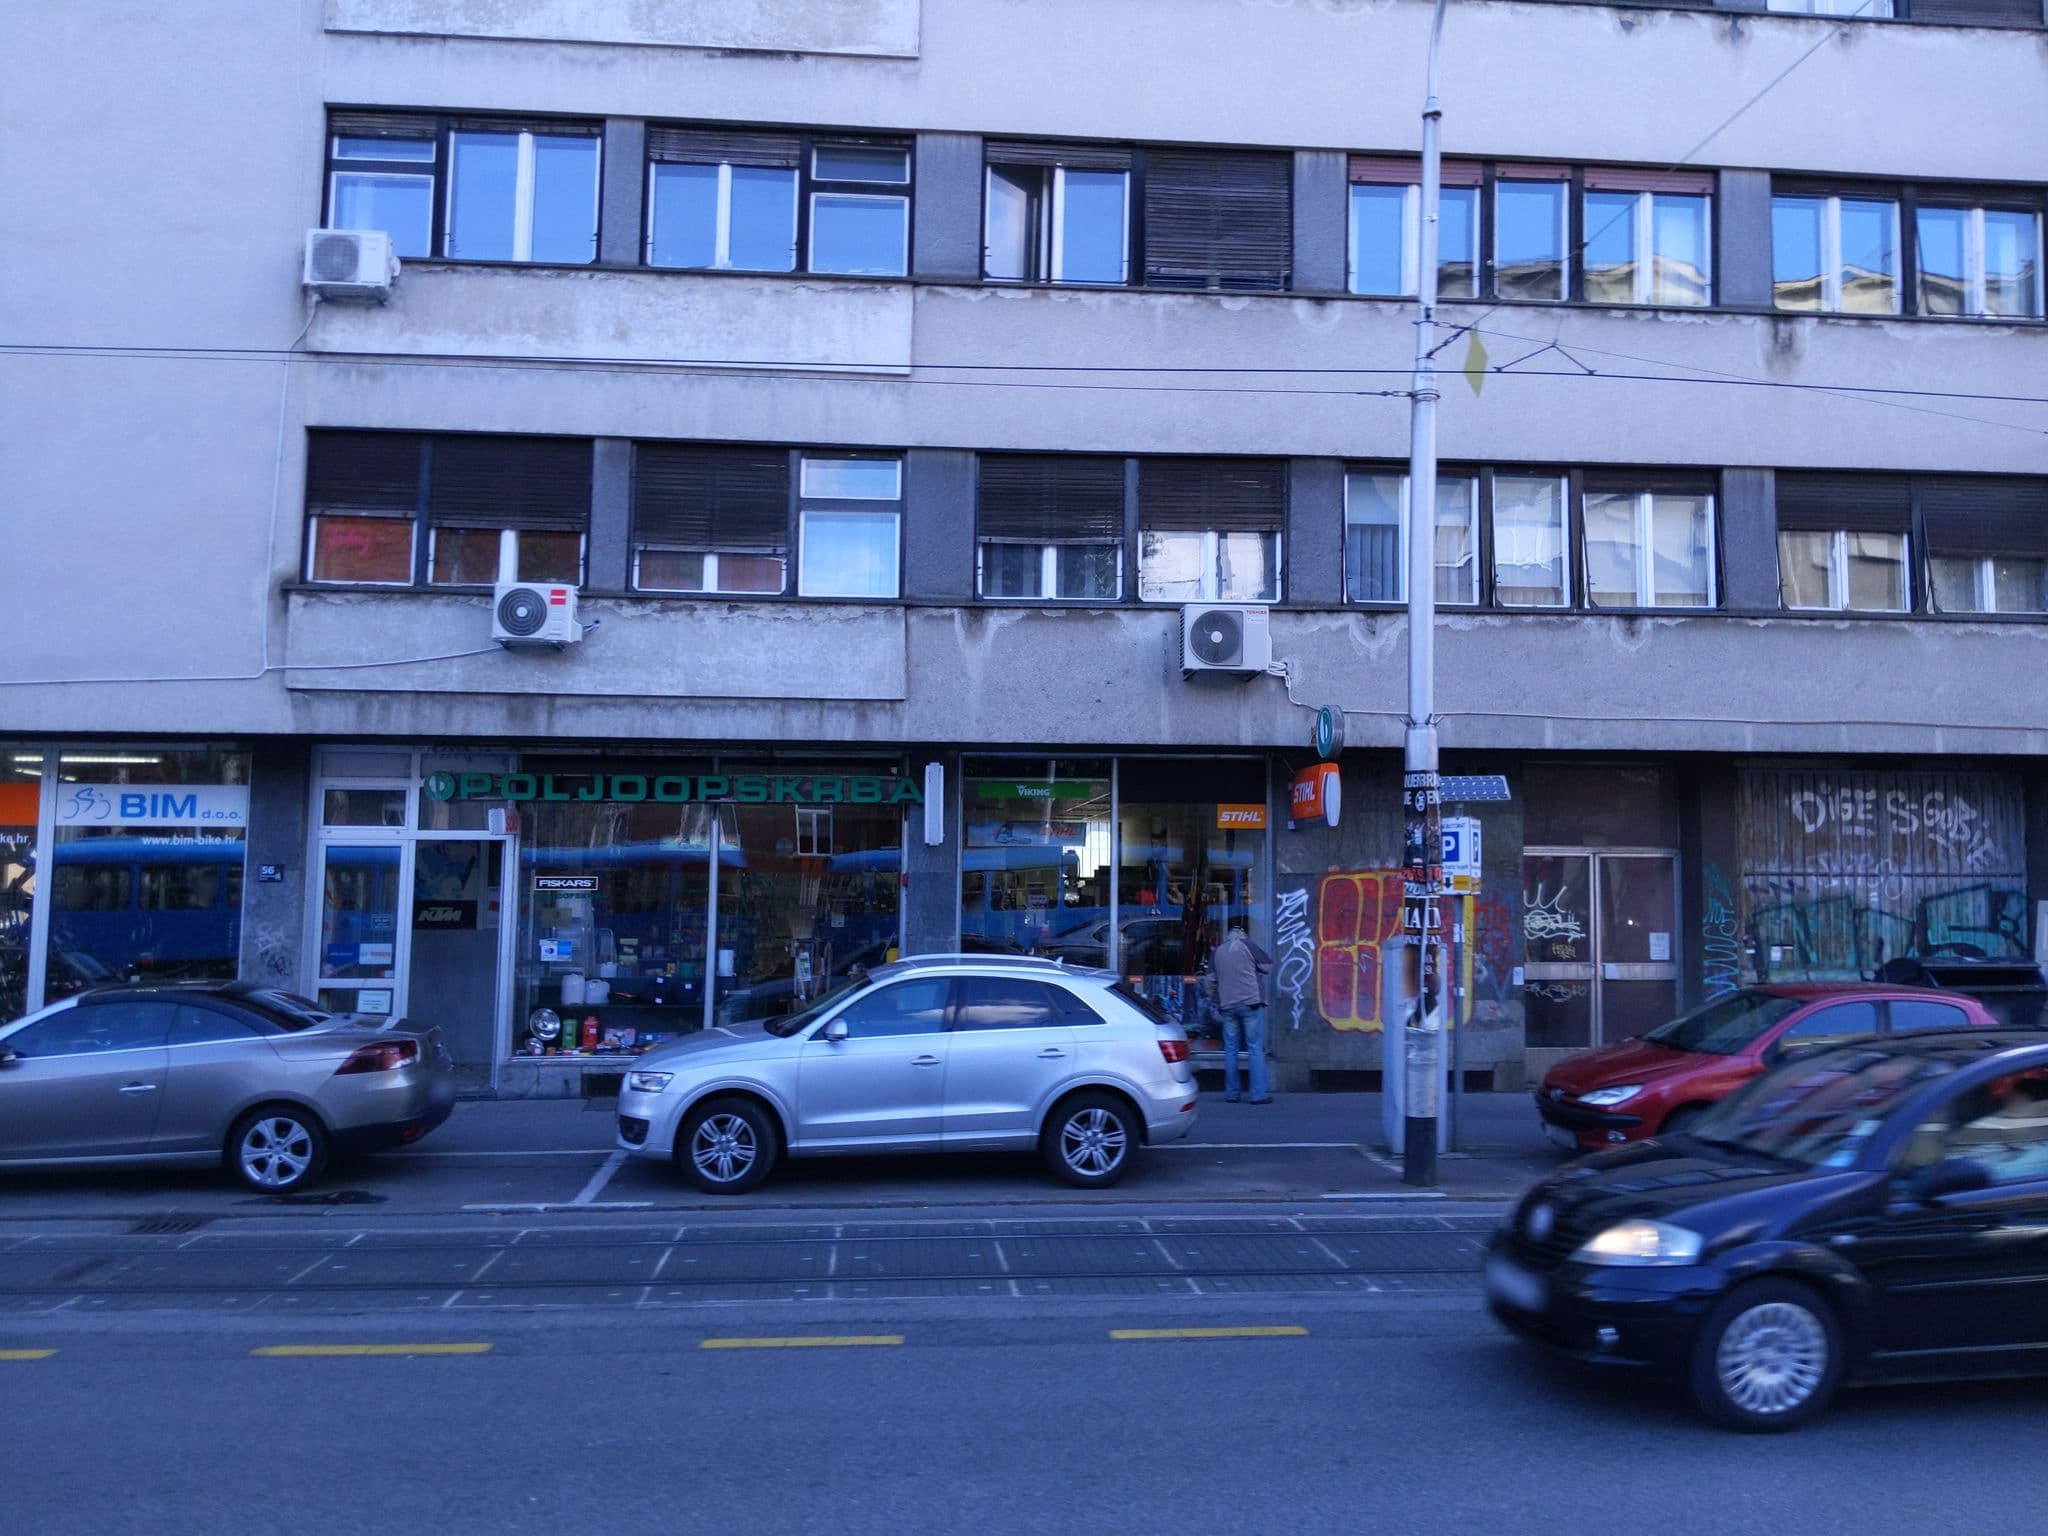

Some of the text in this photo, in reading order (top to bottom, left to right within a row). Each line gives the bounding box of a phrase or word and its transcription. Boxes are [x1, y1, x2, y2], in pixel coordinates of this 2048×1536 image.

[459, 772, 924, 804] POLJOOPSKRBA
[1016, 785, 1050, 796] VIKING
[1293, 780, 1315, 803] STIHL
[119, 793, 242, 819] BIM d.o.o.
[1220, 811, 1262, 822] STIHL
[141, 834, 238, 845] www.bim-bike.hr
[1442, 835, 1456, 860] P
[538, 879, 592, 888] FISKARS
[418, 906, 463, 922] KTM
